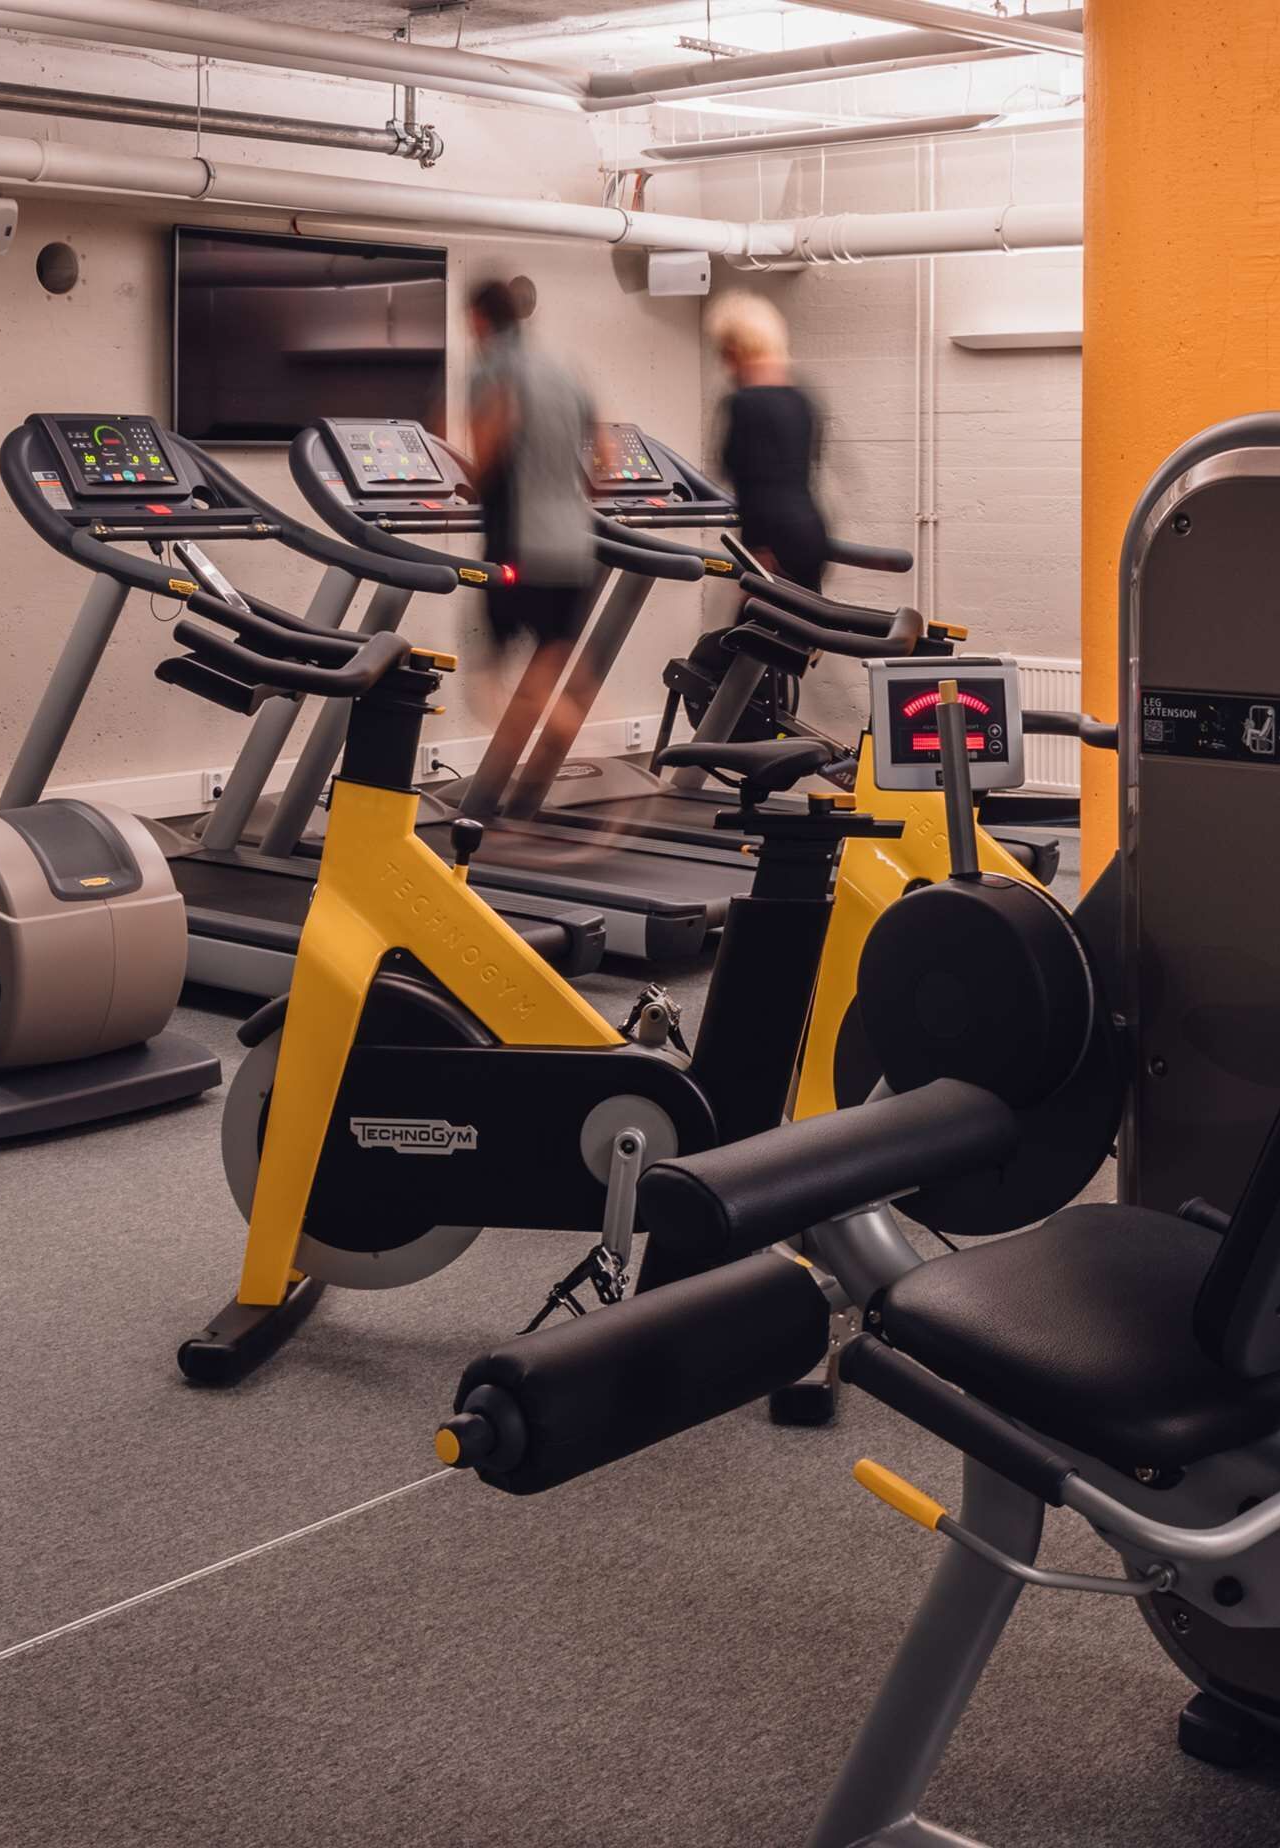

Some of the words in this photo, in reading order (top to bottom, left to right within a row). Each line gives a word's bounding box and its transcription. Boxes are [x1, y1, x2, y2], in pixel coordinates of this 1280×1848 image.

[1143, 697, 1162, 707] LEG
[1143, 706, 1197, 719] EXTENSION
[380, 861, 536, 1020] TECHNOGYM
